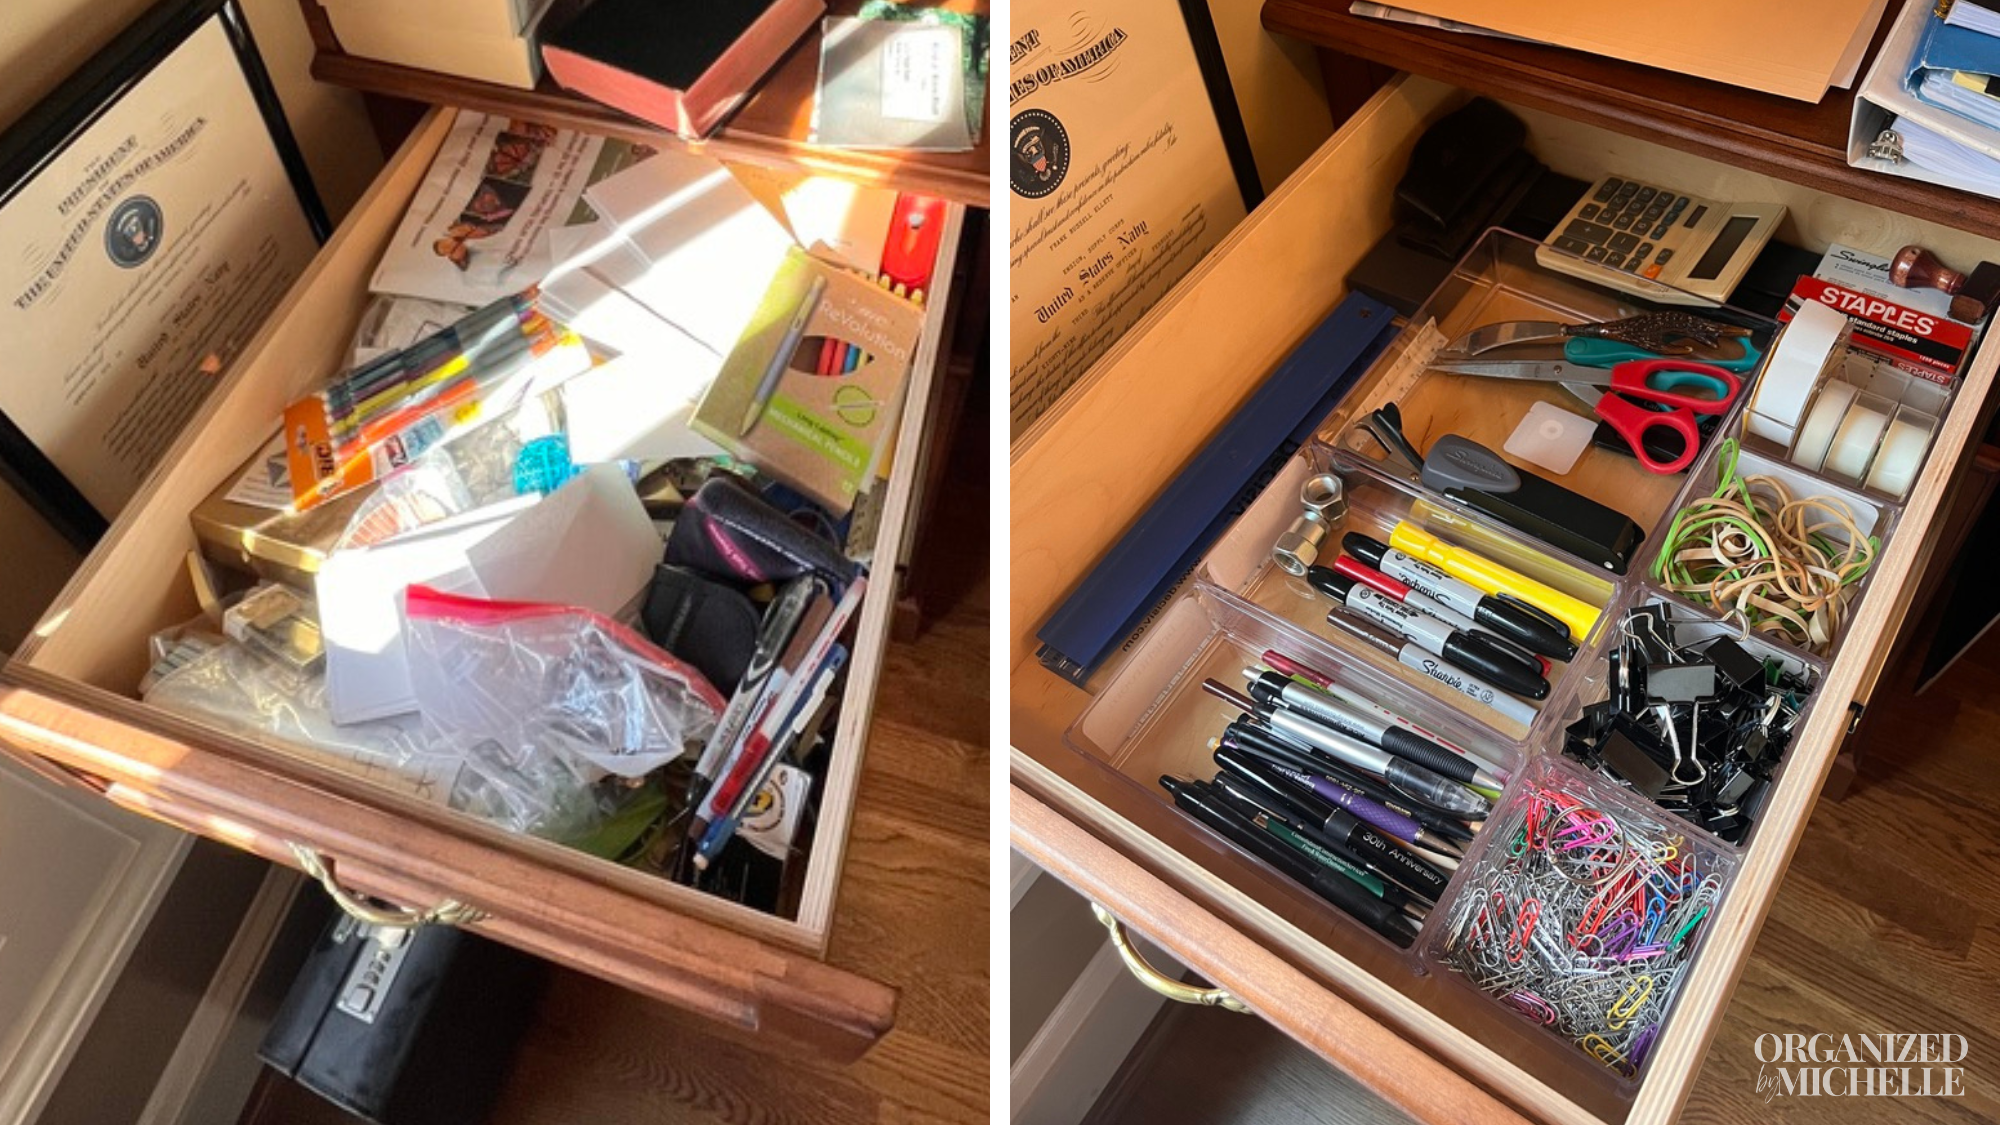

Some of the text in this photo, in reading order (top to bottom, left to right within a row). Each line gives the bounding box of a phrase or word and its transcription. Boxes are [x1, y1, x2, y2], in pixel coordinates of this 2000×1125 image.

[1036, 66, 1060, 88] OF
[1057, 27, 1127, 81] AMERICA
[1034, 287, 1074, 321] United
[1076, 252, 1115, 285] States
[1819, 286, 1935, 336] STAPLES
[1848, 316, 1886, 333] standard
[1887, 328, 1918, 344] staples
[1363, 832, 1442, 884] 30th Anniversary
